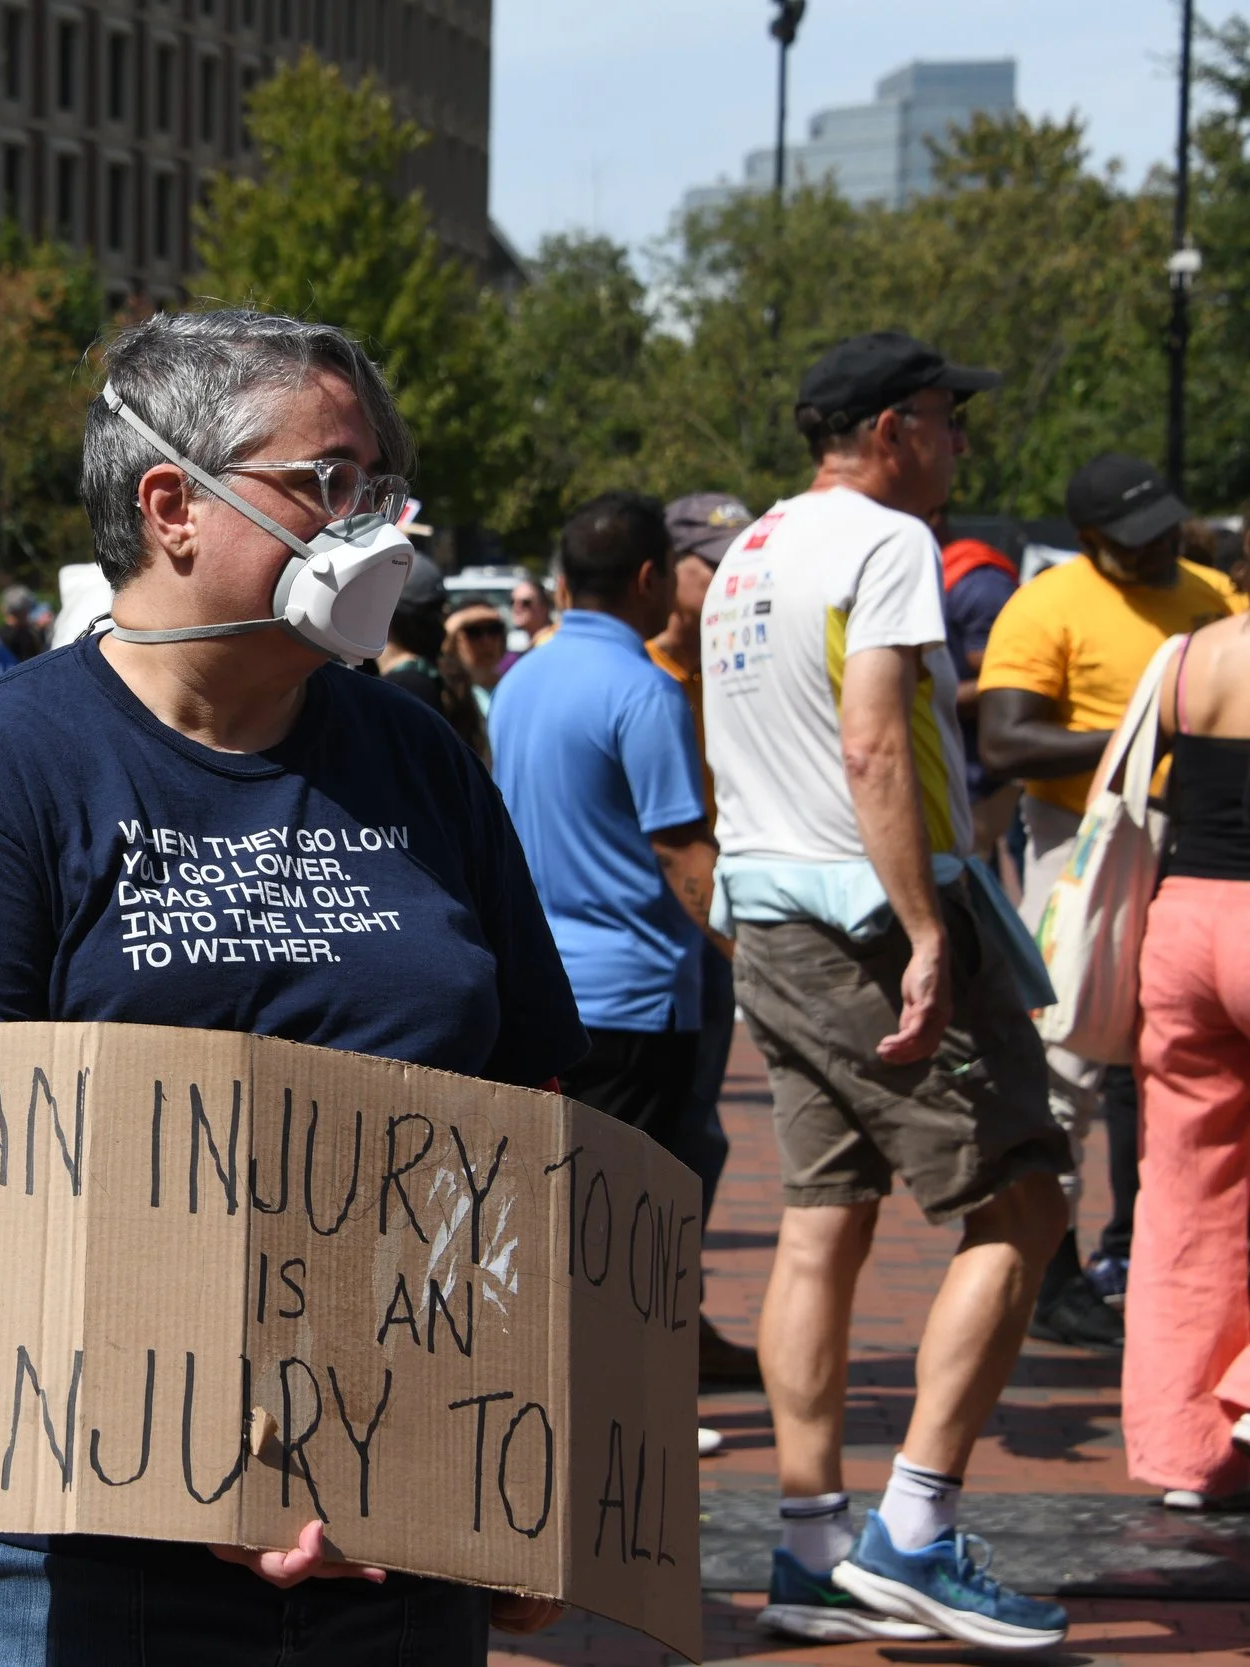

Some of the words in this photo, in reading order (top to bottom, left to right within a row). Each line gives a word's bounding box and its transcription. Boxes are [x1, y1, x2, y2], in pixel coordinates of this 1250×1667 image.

[117, 819, 199, 859] WHEN
[202, 826, 289, 859] THEY
[295, 828, 336, 852] GO
[340, 825, 409, 852] LOW
[122, 850, 170, 885] YOU
[179, 862, 225, 885] GO
[231, 853, 352, 881] LOWER.
[118, 880, 213, 907] DRAG
[215, 880, 308, 908] THEM
[313, 885, 371, 908] OUT
[121, 911, 217, 940] INTO
[223, 908, 291, 934] THE
[295, 911, 401, 934] LIGHT
[122, 942, 172, 970] TO
[181, 938, 341, 964] WITHER.
[151, 1079, 509, 1266] INJURY
[543, 1145, 614, 1288] TO
[628, 1189, 697, 1333] ONE
[256, 1252, 308, 1325] IS
[377, 1272, 474, 1357] AN
[448, 1390, 553, 1540] TO
[597, 1418, 676, 1567] ALL
